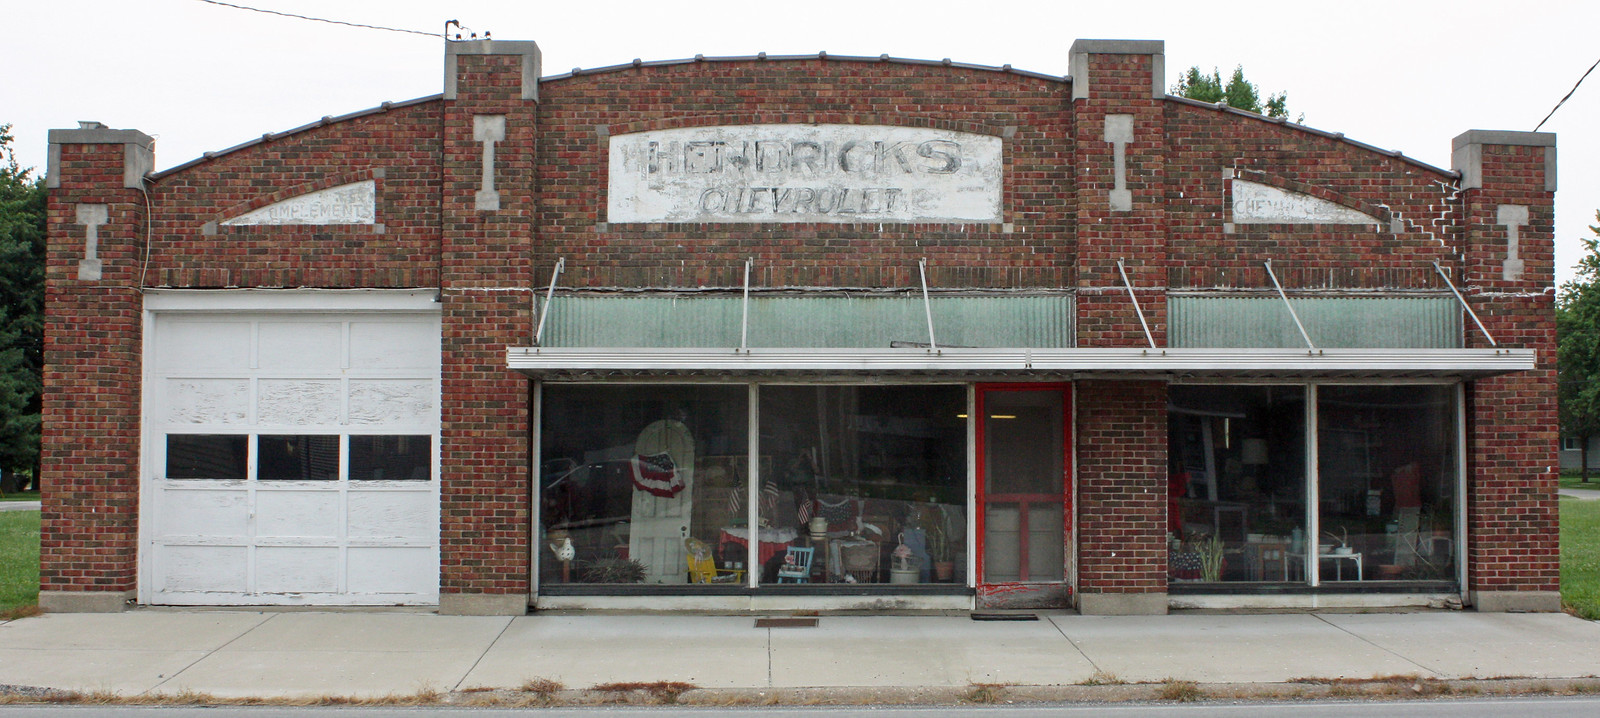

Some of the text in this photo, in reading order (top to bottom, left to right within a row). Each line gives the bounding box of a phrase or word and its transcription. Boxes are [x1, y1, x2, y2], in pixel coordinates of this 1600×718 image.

[648, 140, 962, 174] HENDRICKS
[274, 203, 372, 218] IMPLEMENTS
[698, 187, 902, 214] CHEVROLET
